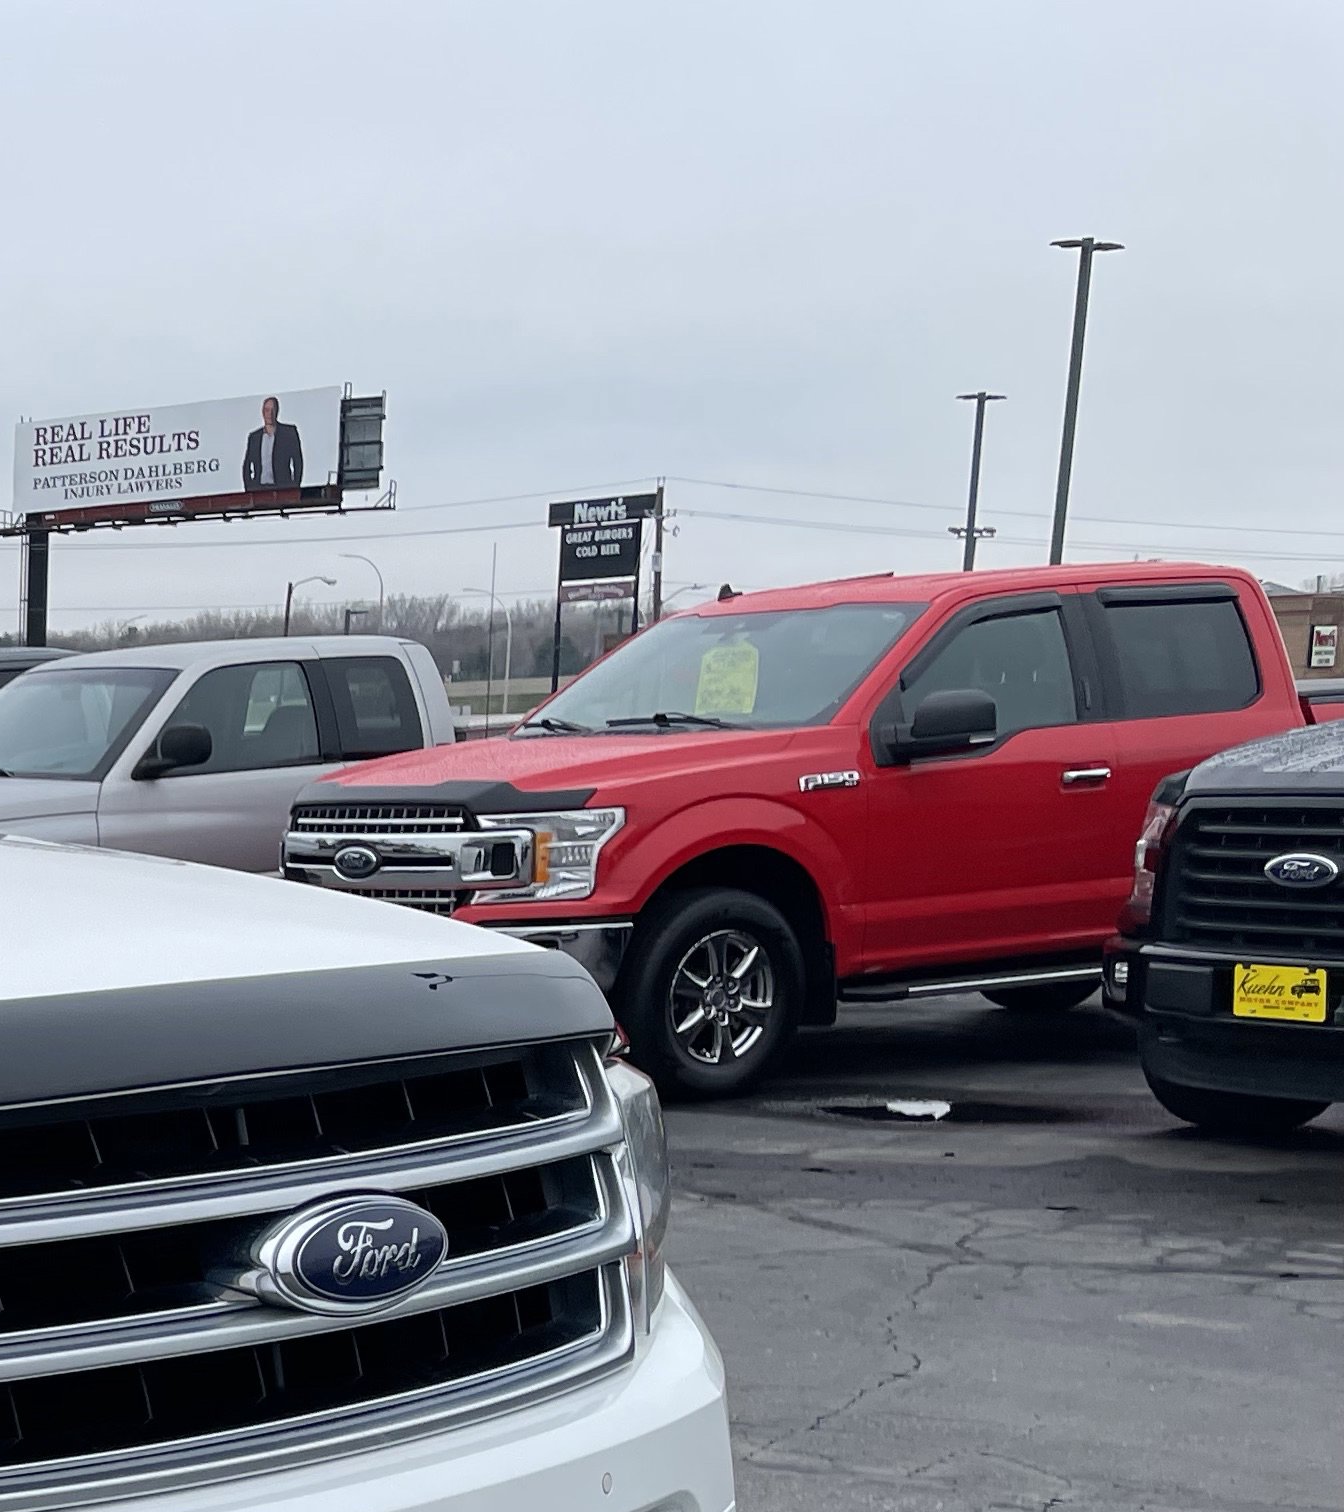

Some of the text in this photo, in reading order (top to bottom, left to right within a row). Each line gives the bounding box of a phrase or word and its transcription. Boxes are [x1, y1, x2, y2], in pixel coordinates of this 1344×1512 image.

[34, 414, 151, 446] REAL LIFE
[32, 430, 200, 467] REAL RESULTS
[32, 458, 221, 490] PATTERSON DAHLBERG
[64, 477, 184, 500] INJURY LAWYERS
[573, 498, 627, 524] Newt's
[1236, 972, 1285, 997] Kuehn
[333, 1217, 422, 1282] Ford
